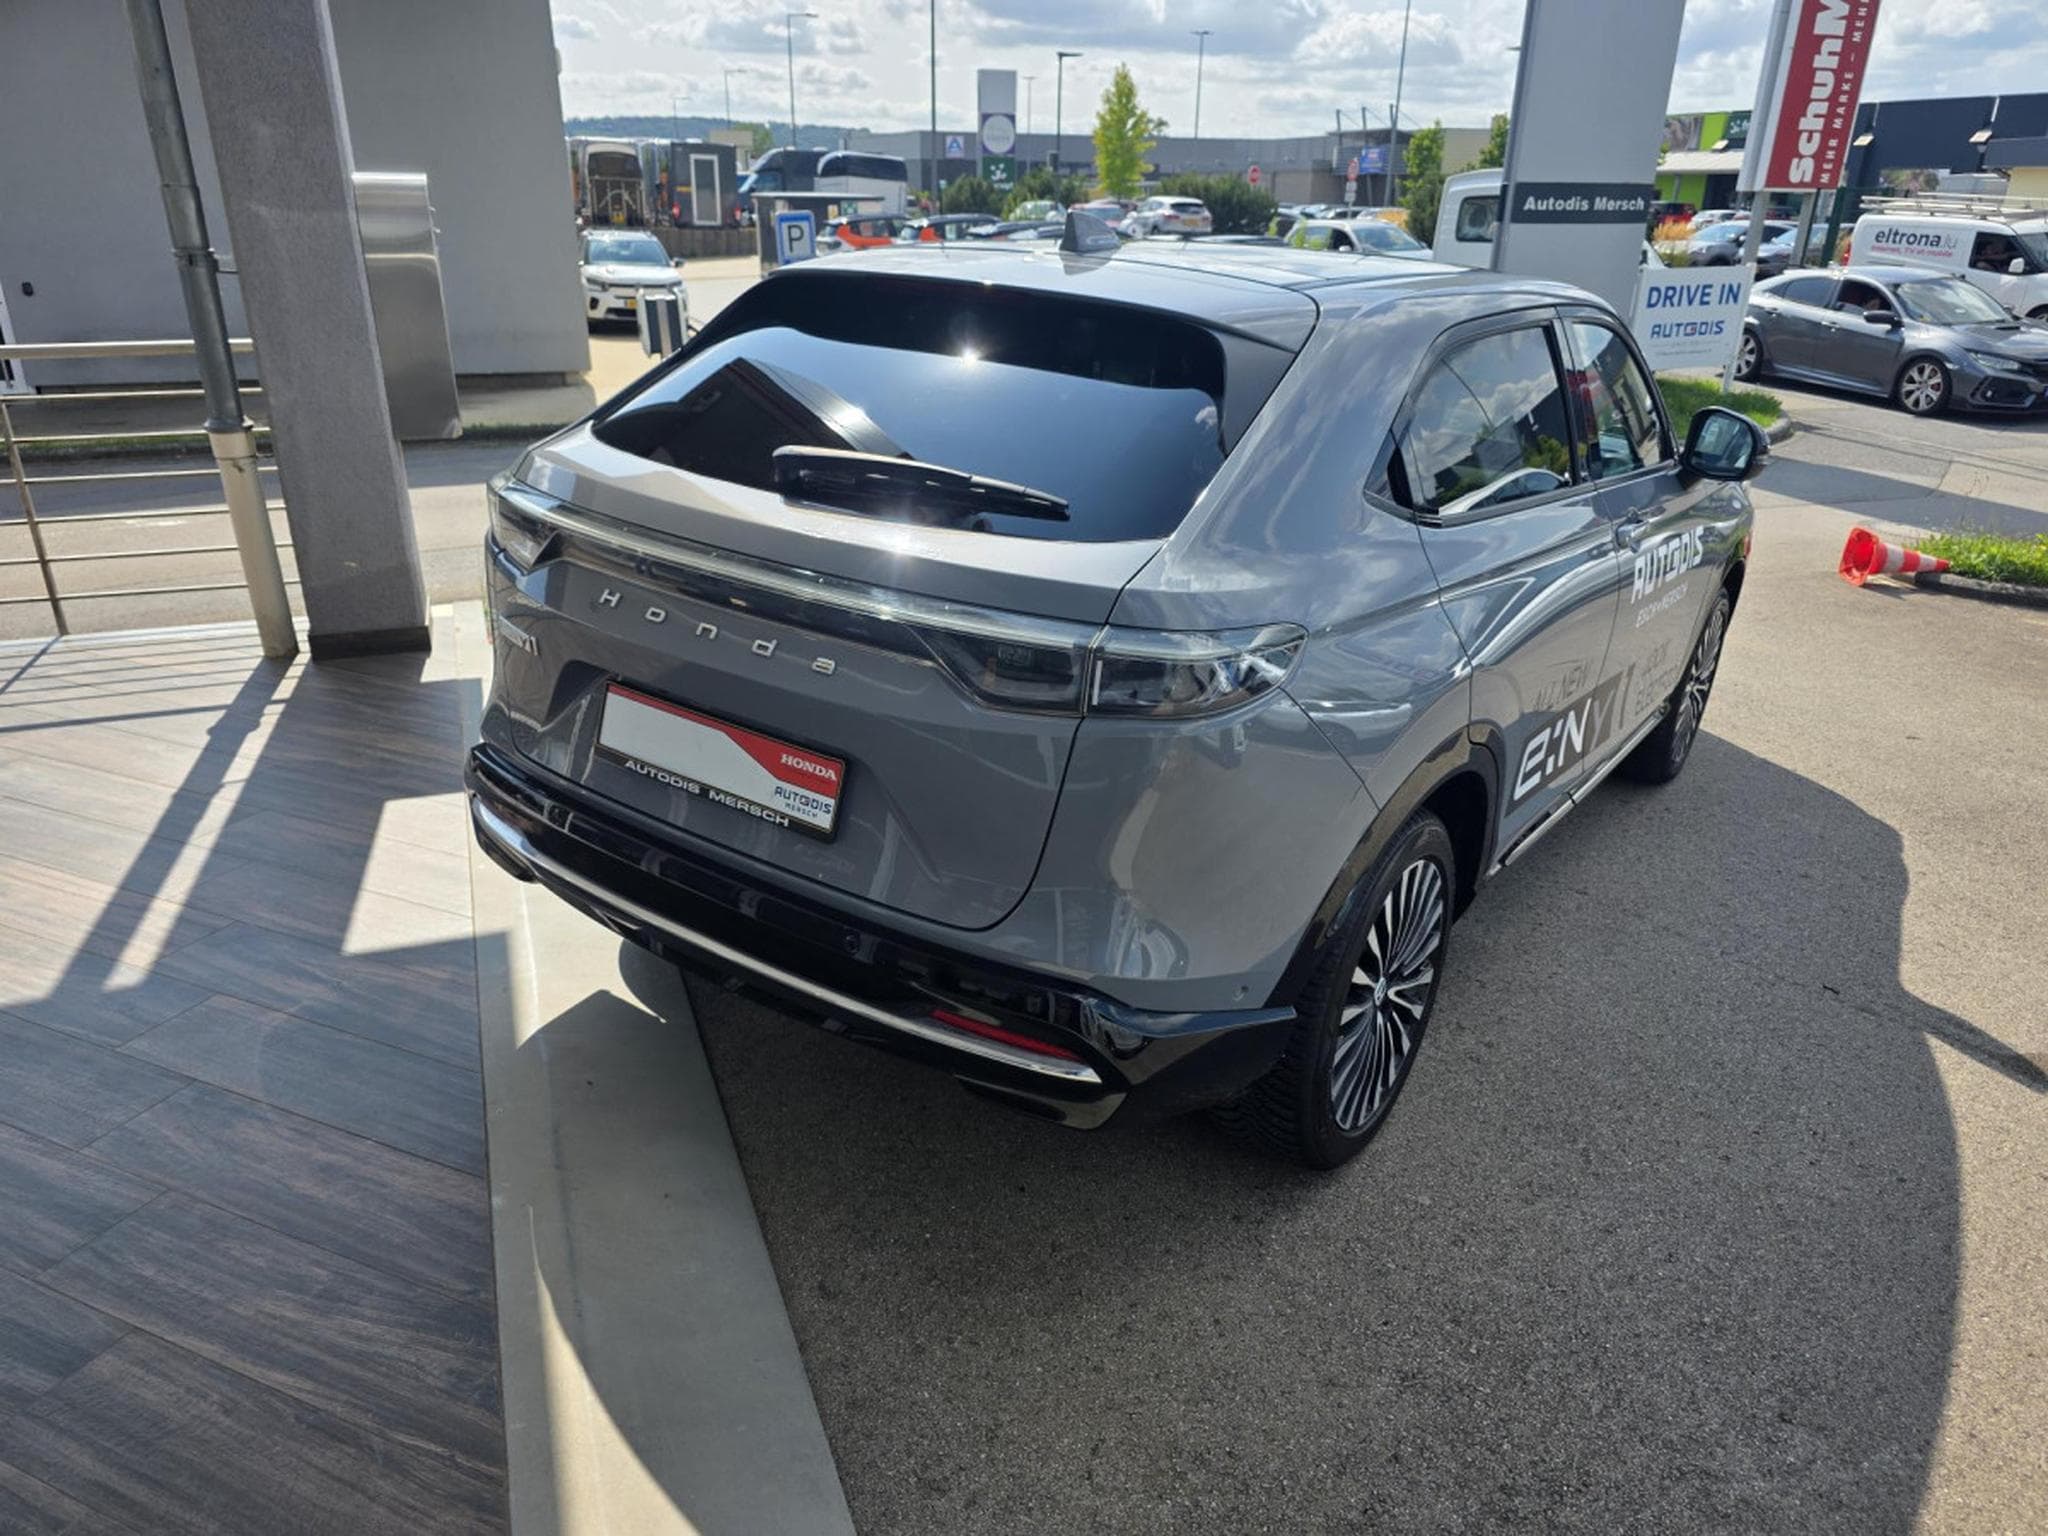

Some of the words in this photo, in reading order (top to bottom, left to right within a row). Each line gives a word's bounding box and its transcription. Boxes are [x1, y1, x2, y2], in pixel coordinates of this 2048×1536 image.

[1820, 138, 1839, 184] MEHR
[1832, 72, 1854, 129] MARKE
[1523, 196, 1589, 211] Autodis
[1593, 196, 1645, 211] Mersch
[787, 224, 805, 254] P
[1646, 284, 1714, 309] DRIVE
[1718, 282, 1742, 305] IN
[780, 753, 838, 781] HONDA
[625, 759, 701, 795] AUTODIS
[708, 790, 790, 828] MERSCH
